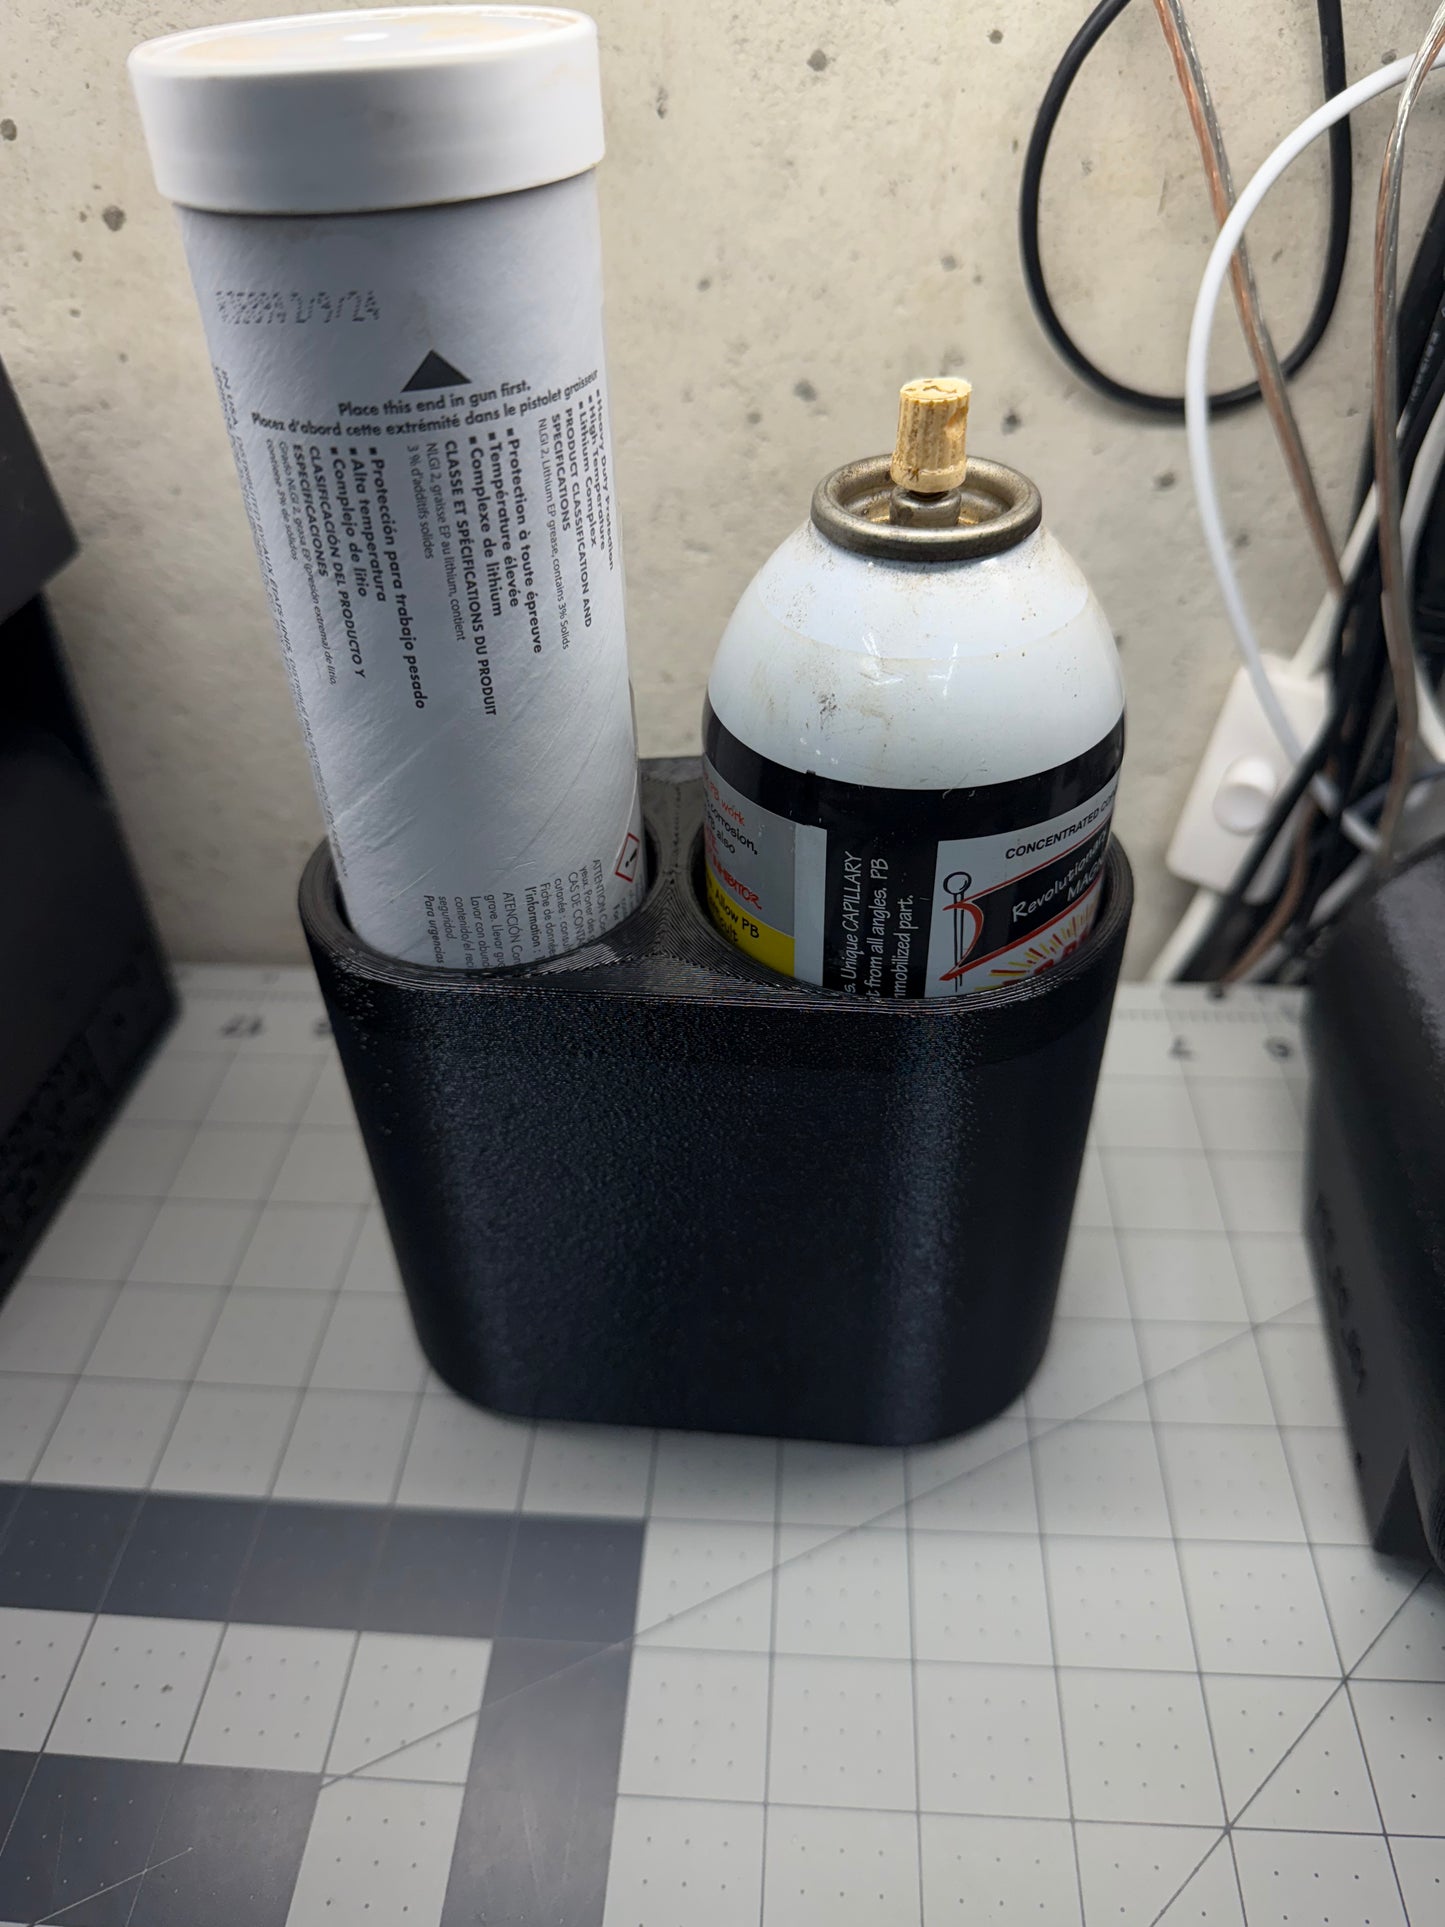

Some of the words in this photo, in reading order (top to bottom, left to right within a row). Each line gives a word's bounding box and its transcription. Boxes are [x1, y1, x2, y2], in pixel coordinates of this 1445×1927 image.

[338, 399, 380, 418] Place
[383, 398, 412, 416] this
[416, 394, 447, 414] end
[450, 393, 466, 408] in
[470, 388, 498, 408] gun
[500, 379, 532, 399] first.
[346, 422, 382, 437] cette
[386, 415, 461, 435] extrémité
[465, 407, 500, 425] dans
[503, 402, 516, 418] le
[519, 388, 562, 417] pistolet
[563, 369, 599, 401] graisseur
[538, 417, 550, 448] NLGI
[564, 407, 579, 479] PRODUCT
[579, 411, 590, 474] Lithium
[588, 406, 598, 445] High
[427, 441, 440, 469] NLGI
[444, 440, 464, 496] CLASSE
[551, 413, 571, 532] SPECIFICATIONS
[600, 455, 609, 490] Duty
[350, 459, 368, 495] Alta
[411, 468, 428, 519] d'additifs
[469, 448, 491, 533] Complexe
[508, 438, 528, 526] Protection
[541, 460, 553, 504] Lithium
[281, 506, 292, 520] de
[293, 444, 329, 577] ESPECIFICACIONES
[309, 445, 341, 559] CLASIFICACIÓN
[332, 459, 357, 539] Complejo
[371, 458, 398, 546] Protección
[430, 485, 447, 525] graisse
[453, 501, 467, 516] ET
[546, 504, 557, 518] EP
[584, 476, 597, 548] Complex
[591, 450, 606, 551] Temperature
[284, 521, 299, 561] sólidos
[419, 520, 434, 560] solides
[438, 525, 450, 540] EP
[488, 442, 512, 551] Température
[503, 555, 519, 608] élevée
[519, 529, 528, 541] à
[545, 519, 559, 559] grease,
[571, 481, 590, 595] CLASSIFICATION
[604, 495, 615, 572] Protection
[348, 543, 361, 563] de
[358, 498, 387, 602] temperatura
[440, 540, 451, 553] au
[482, 537, 497, 558] de
[520, 544, 534, 587] toute
[333, 561, 347, 586] DEL
[353, 566, 371, 598] litio
[384, 551, 403, 590] para
[443, 555, 458, 601] lithium,
[456, 522, 485, 633] SPÉCIFICATIONS
[485, 562, 502, 617] lithium
[552, 559, 565, 602] contains
[293, 518, 307, 547] grasa
[304, 562, 320, 605] (presión
[313, 606, 331, 652] extrema)
[324, 651, 335, 664] de
[558, 602, 568, 619] 3%
[338, 590, 363, 666] PRODUCTO
[395, 594, 417, 651] trabajo
[450, 601, 466, 641] contient
[524, 593, 542, 654] épreuve
[582, 597, 593, 628] AND
[474, 636, 488, 656] DU
[559, 620, 570, 650] Solids
[354, 668, 367, 679] Y
[403, 656, 429, 710] pesado
[477, 658, 497, 716] PRODUIT
[716, 829, 736, 854] also
[1005, 807, 1100, 860] CONCENTRATED
[568, 871, 580, 893] CAS
[592, 859, 609, 914] ATTENTION
[870, 858, 889, 879] PB
[424, 894, 435, 918] Para
[470, 895, 483, 921] Lavar
[484, 894, 498, 922] grave.
[540, 882, 553, 907] Fiche
[554, 878, 567, 913] cutanée
[570, 893, 582, 909] DE
[583, 889, 594, 916] Porter
[842, 850, 862, 932] CAPILLARY
[438, 896, 458, 941] seguridad.
[454, 896, 476, 952] contenido/el
[475, 921, 485, 938] con
[502, 891, 523, 943] ATENCIÓN
[524, 885, 543, 948] l'information
[543, 908, 555, 921] de
[573, 908, 588, 944] CONTA
[742, 916, 760, 939] PB
[868, 887, 891, 936] angles.
[897, 894, 920, 930] part.
[427, 919, 446, 964] urgencias
[478, 940, 491, 968] abund
[491, 924, 504, 950] Llevar
[560, 921, 574, 948] consul
[866, 937, 884, 955] all
[464, 952, 476, 968] reci
[493, 951, 506, 968] gua
[511, 945, 524, 964] Con
[840, 933, 865, 980] Unique
[864, 956, 883, 988] from
